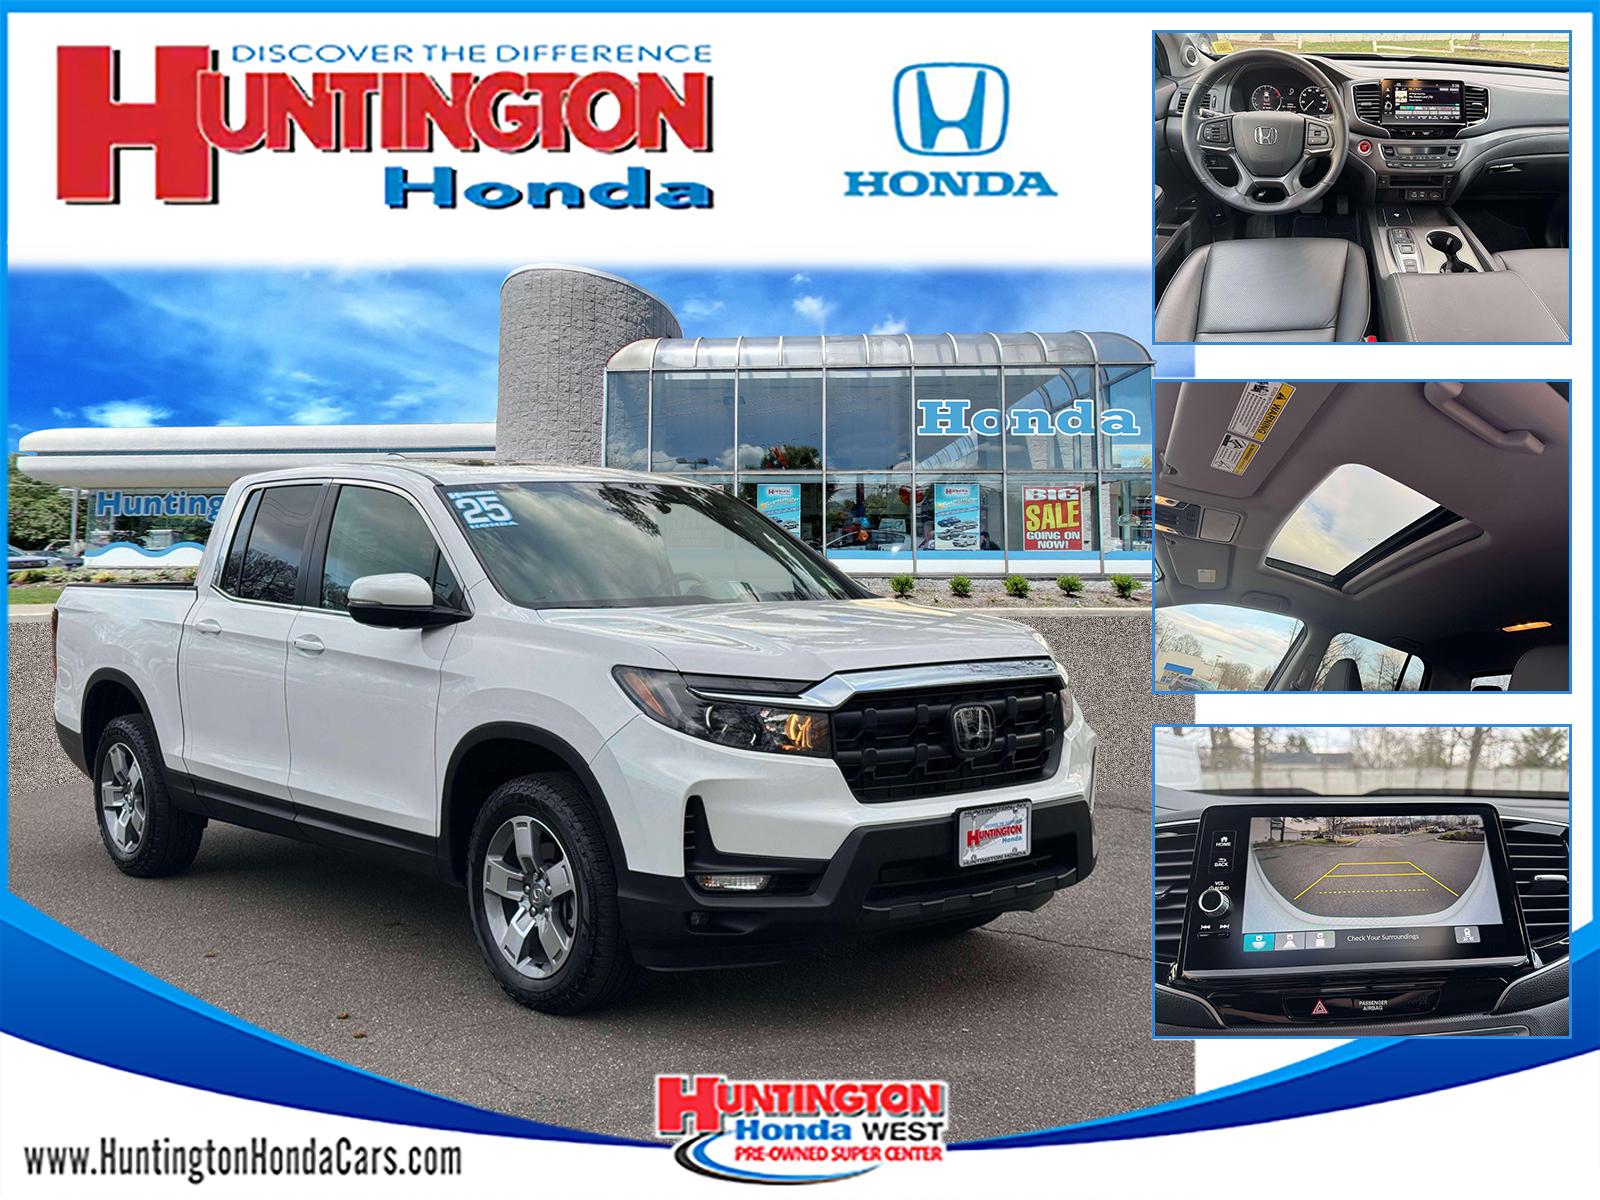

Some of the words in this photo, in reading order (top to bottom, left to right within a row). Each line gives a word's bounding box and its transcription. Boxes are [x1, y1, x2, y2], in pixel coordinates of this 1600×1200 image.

[916, 399, 1141, 436] Honda
[1258, 403, 1282, 434] WARNING
[1025, 488, 1080, 501] BIG
[455, 496, 513, 524] 25
[1025, 500, 1080, 532] SALE
[1026, 531, 1061, 541] GOING
[1063, 531, 1080, 540] ON
[1037, 540, 1069, 549] NOW!
[966, 825, 1022, 848] HUNTINGTON
[1381, 933, 1420, 941] Surroundings
